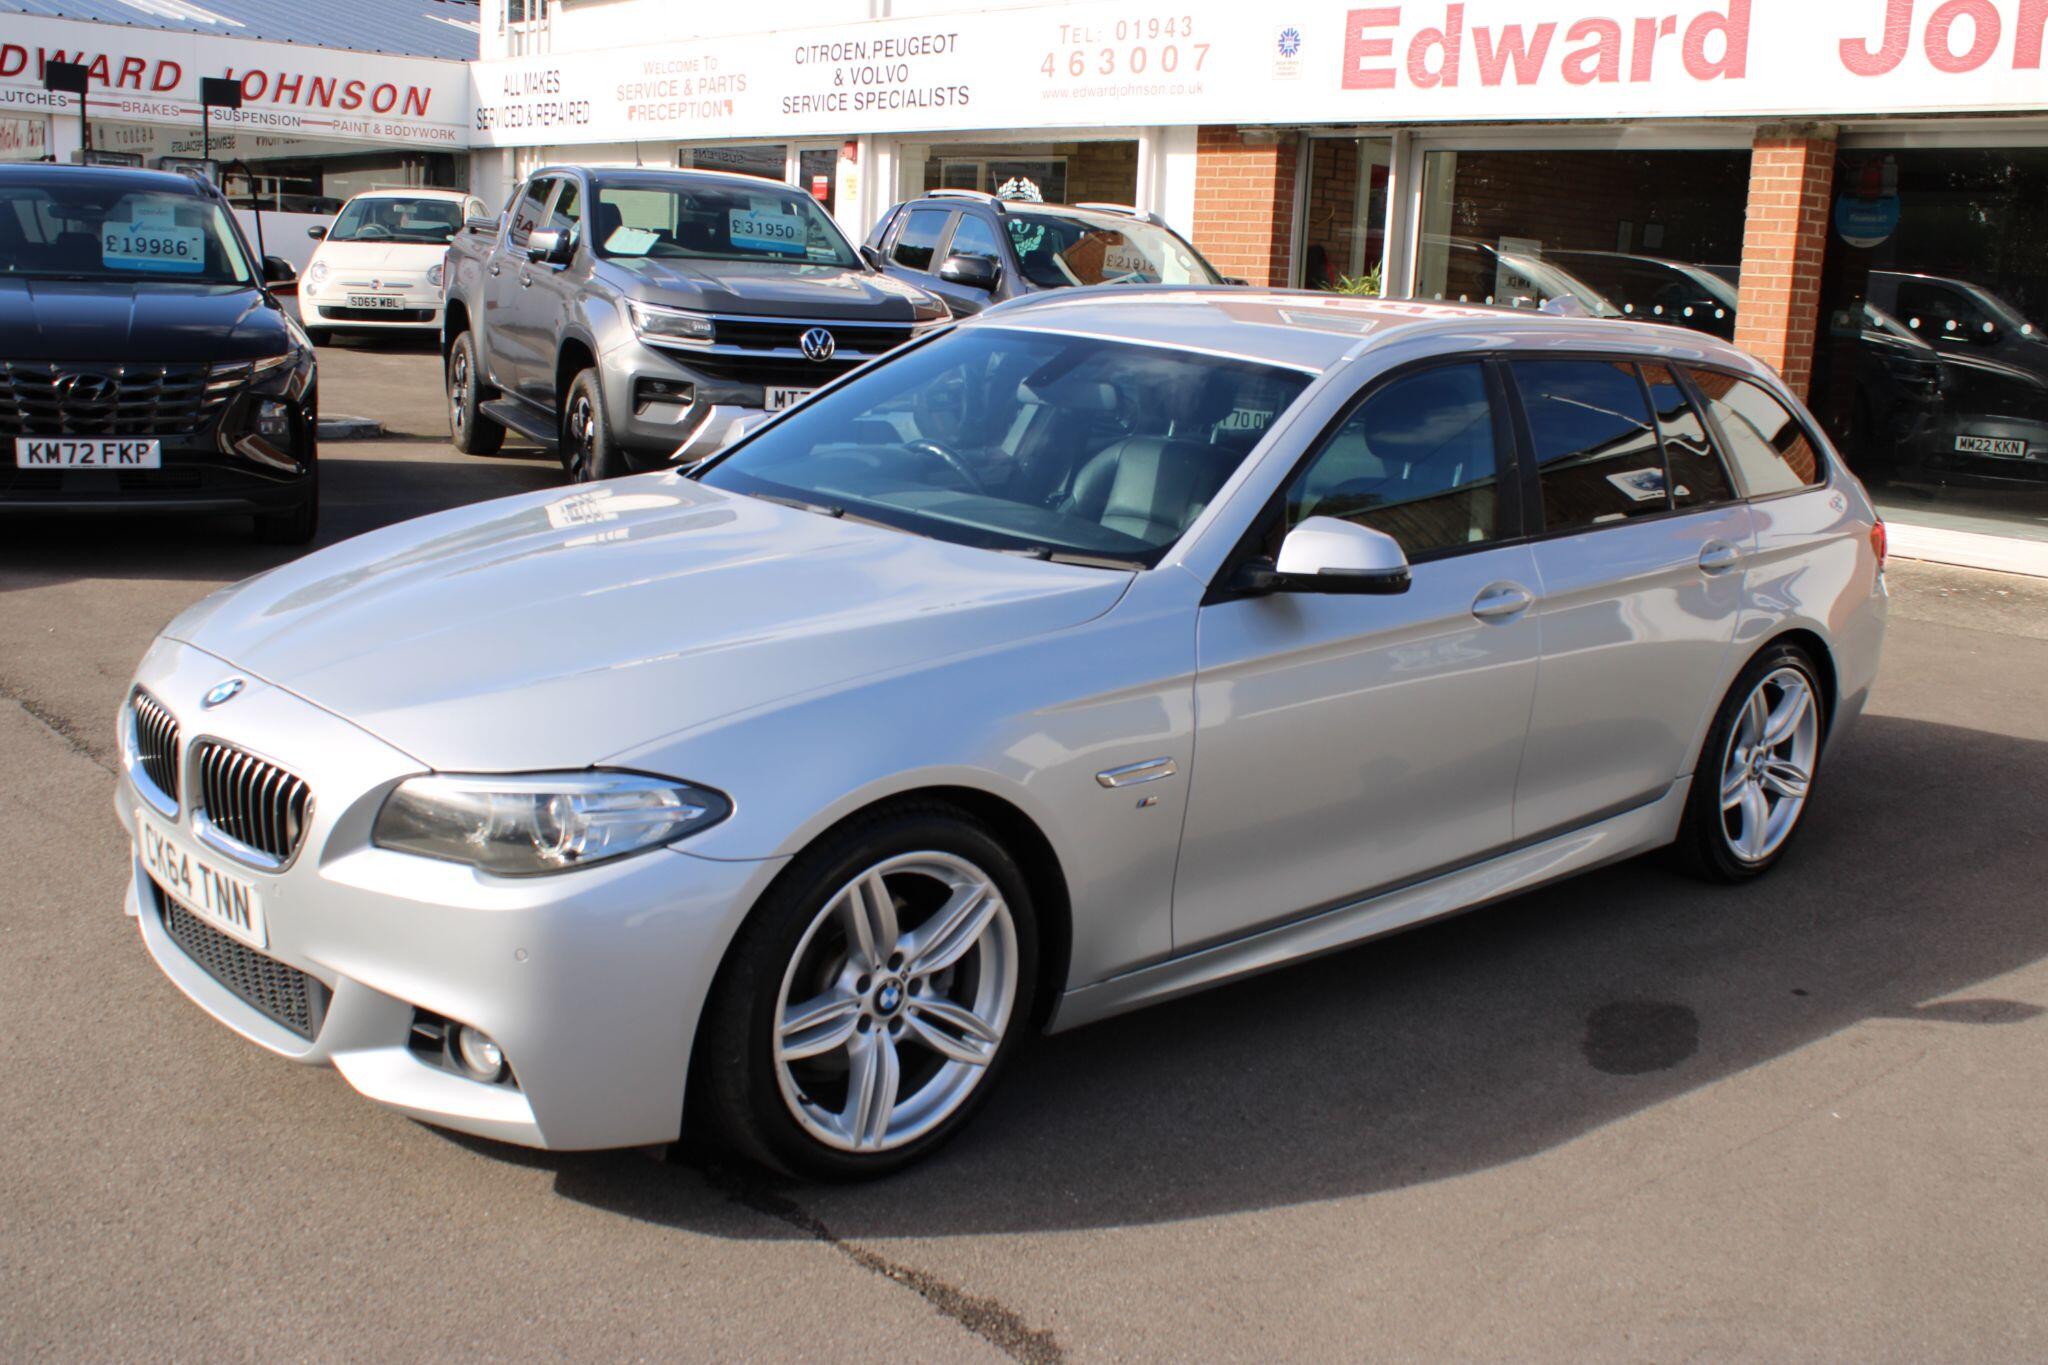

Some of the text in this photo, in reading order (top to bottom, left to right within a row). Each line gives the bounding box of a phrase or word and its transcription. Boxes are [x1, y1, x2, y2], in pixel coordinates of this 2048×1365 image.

[1116, 15, 1192, 41] 01943
[1341, 0, 1752, 90] Edward
[1040, 43, 1211, 78] 463007
[504, 69, 560, 96] ALL MAKES
[616, 73, 747, 102] SERVICE & PARTS
[834, 63, 909, 86] & VOLVO
[638, 101, 723, 121] RECEPTION
[783, 85, 970, 114] SERVICE SPECIALISTS
[121, 101, 180, 117] BRAKES
[214, 109, 301, 128] SUSPENSION
[332, 119, 371, 134] PAINT
[373, 123, 382, 136] &
[385, 124, 457, 142] BODYWORK
[476, 100, 590, 131] SERVICED & REPAIRED
[732, 219, 795, 239] £31950
[105, 235, 188, 257] £19986
[28, 443, 151, 465] KM72 FKP
[1993, 439, 2020, 454] KKN
[198, 862, 253, 932] TNN
